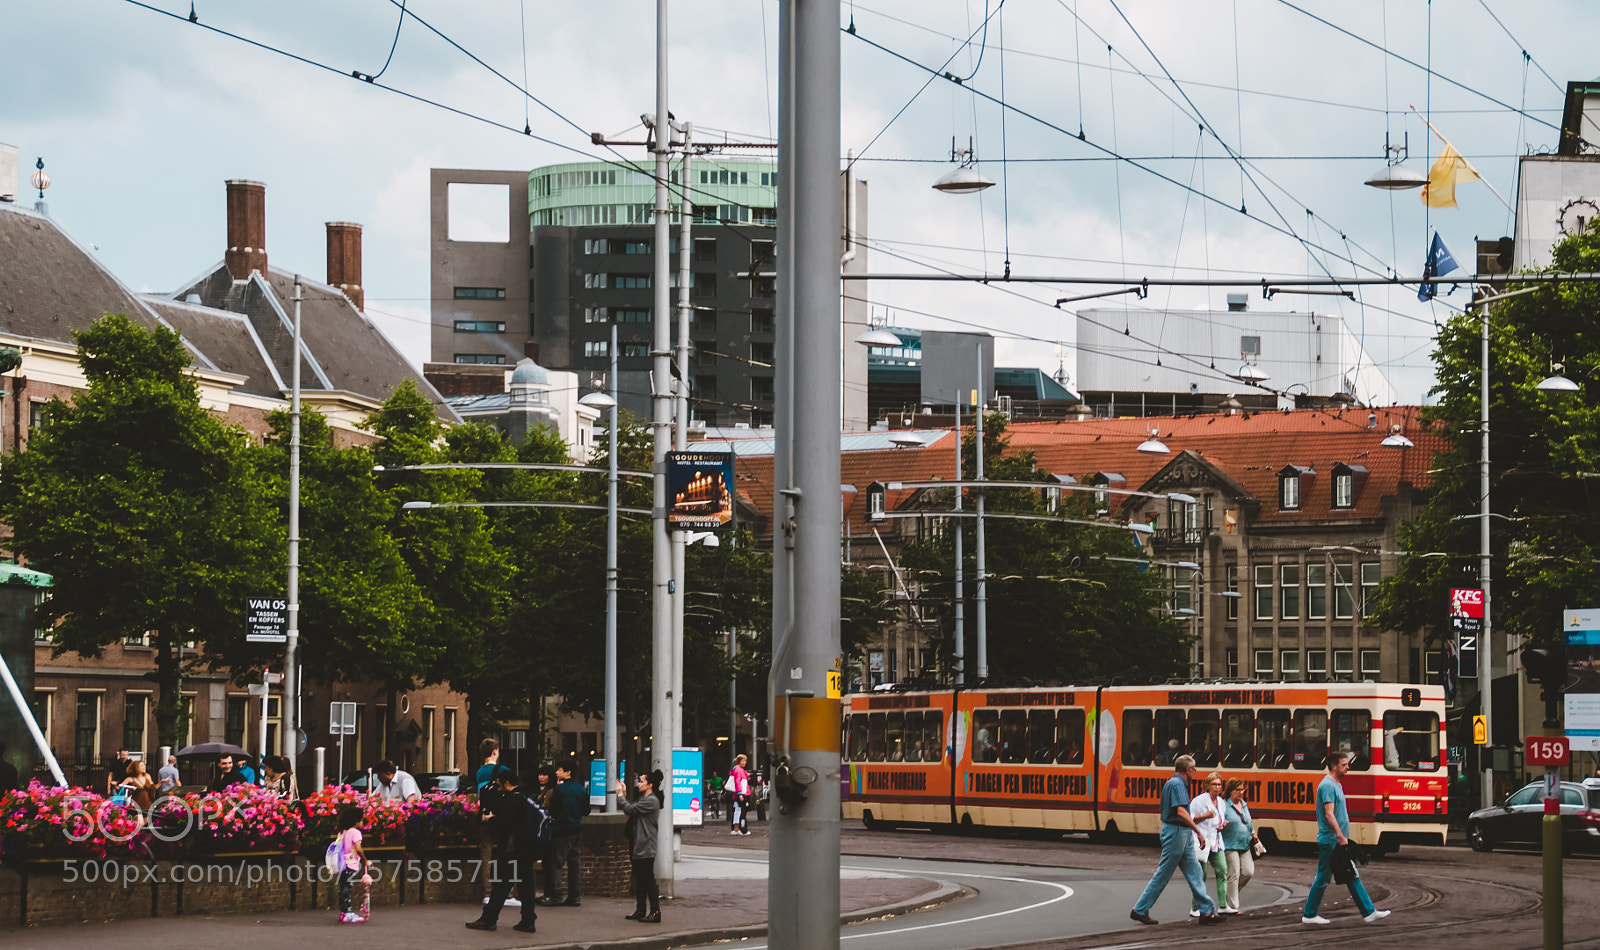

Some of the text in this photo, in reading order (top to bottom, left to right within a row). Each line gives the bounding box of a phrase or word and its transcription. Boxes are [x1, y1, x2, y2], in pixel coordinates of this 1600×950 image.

[1453, 589, 1482, 601] KFC
[249, 599, 286, 610] VAN OS
[1530, 741, 1564, 759] 159
[969, 772, 1087, 796] 7 DAGEN PER WEEK GEOPEND
[1125, 776, 1170, 799] SHOPPI
[1267, 781, 1315, 805] HORECA
[1403, 802, 1422, 811] 3124
